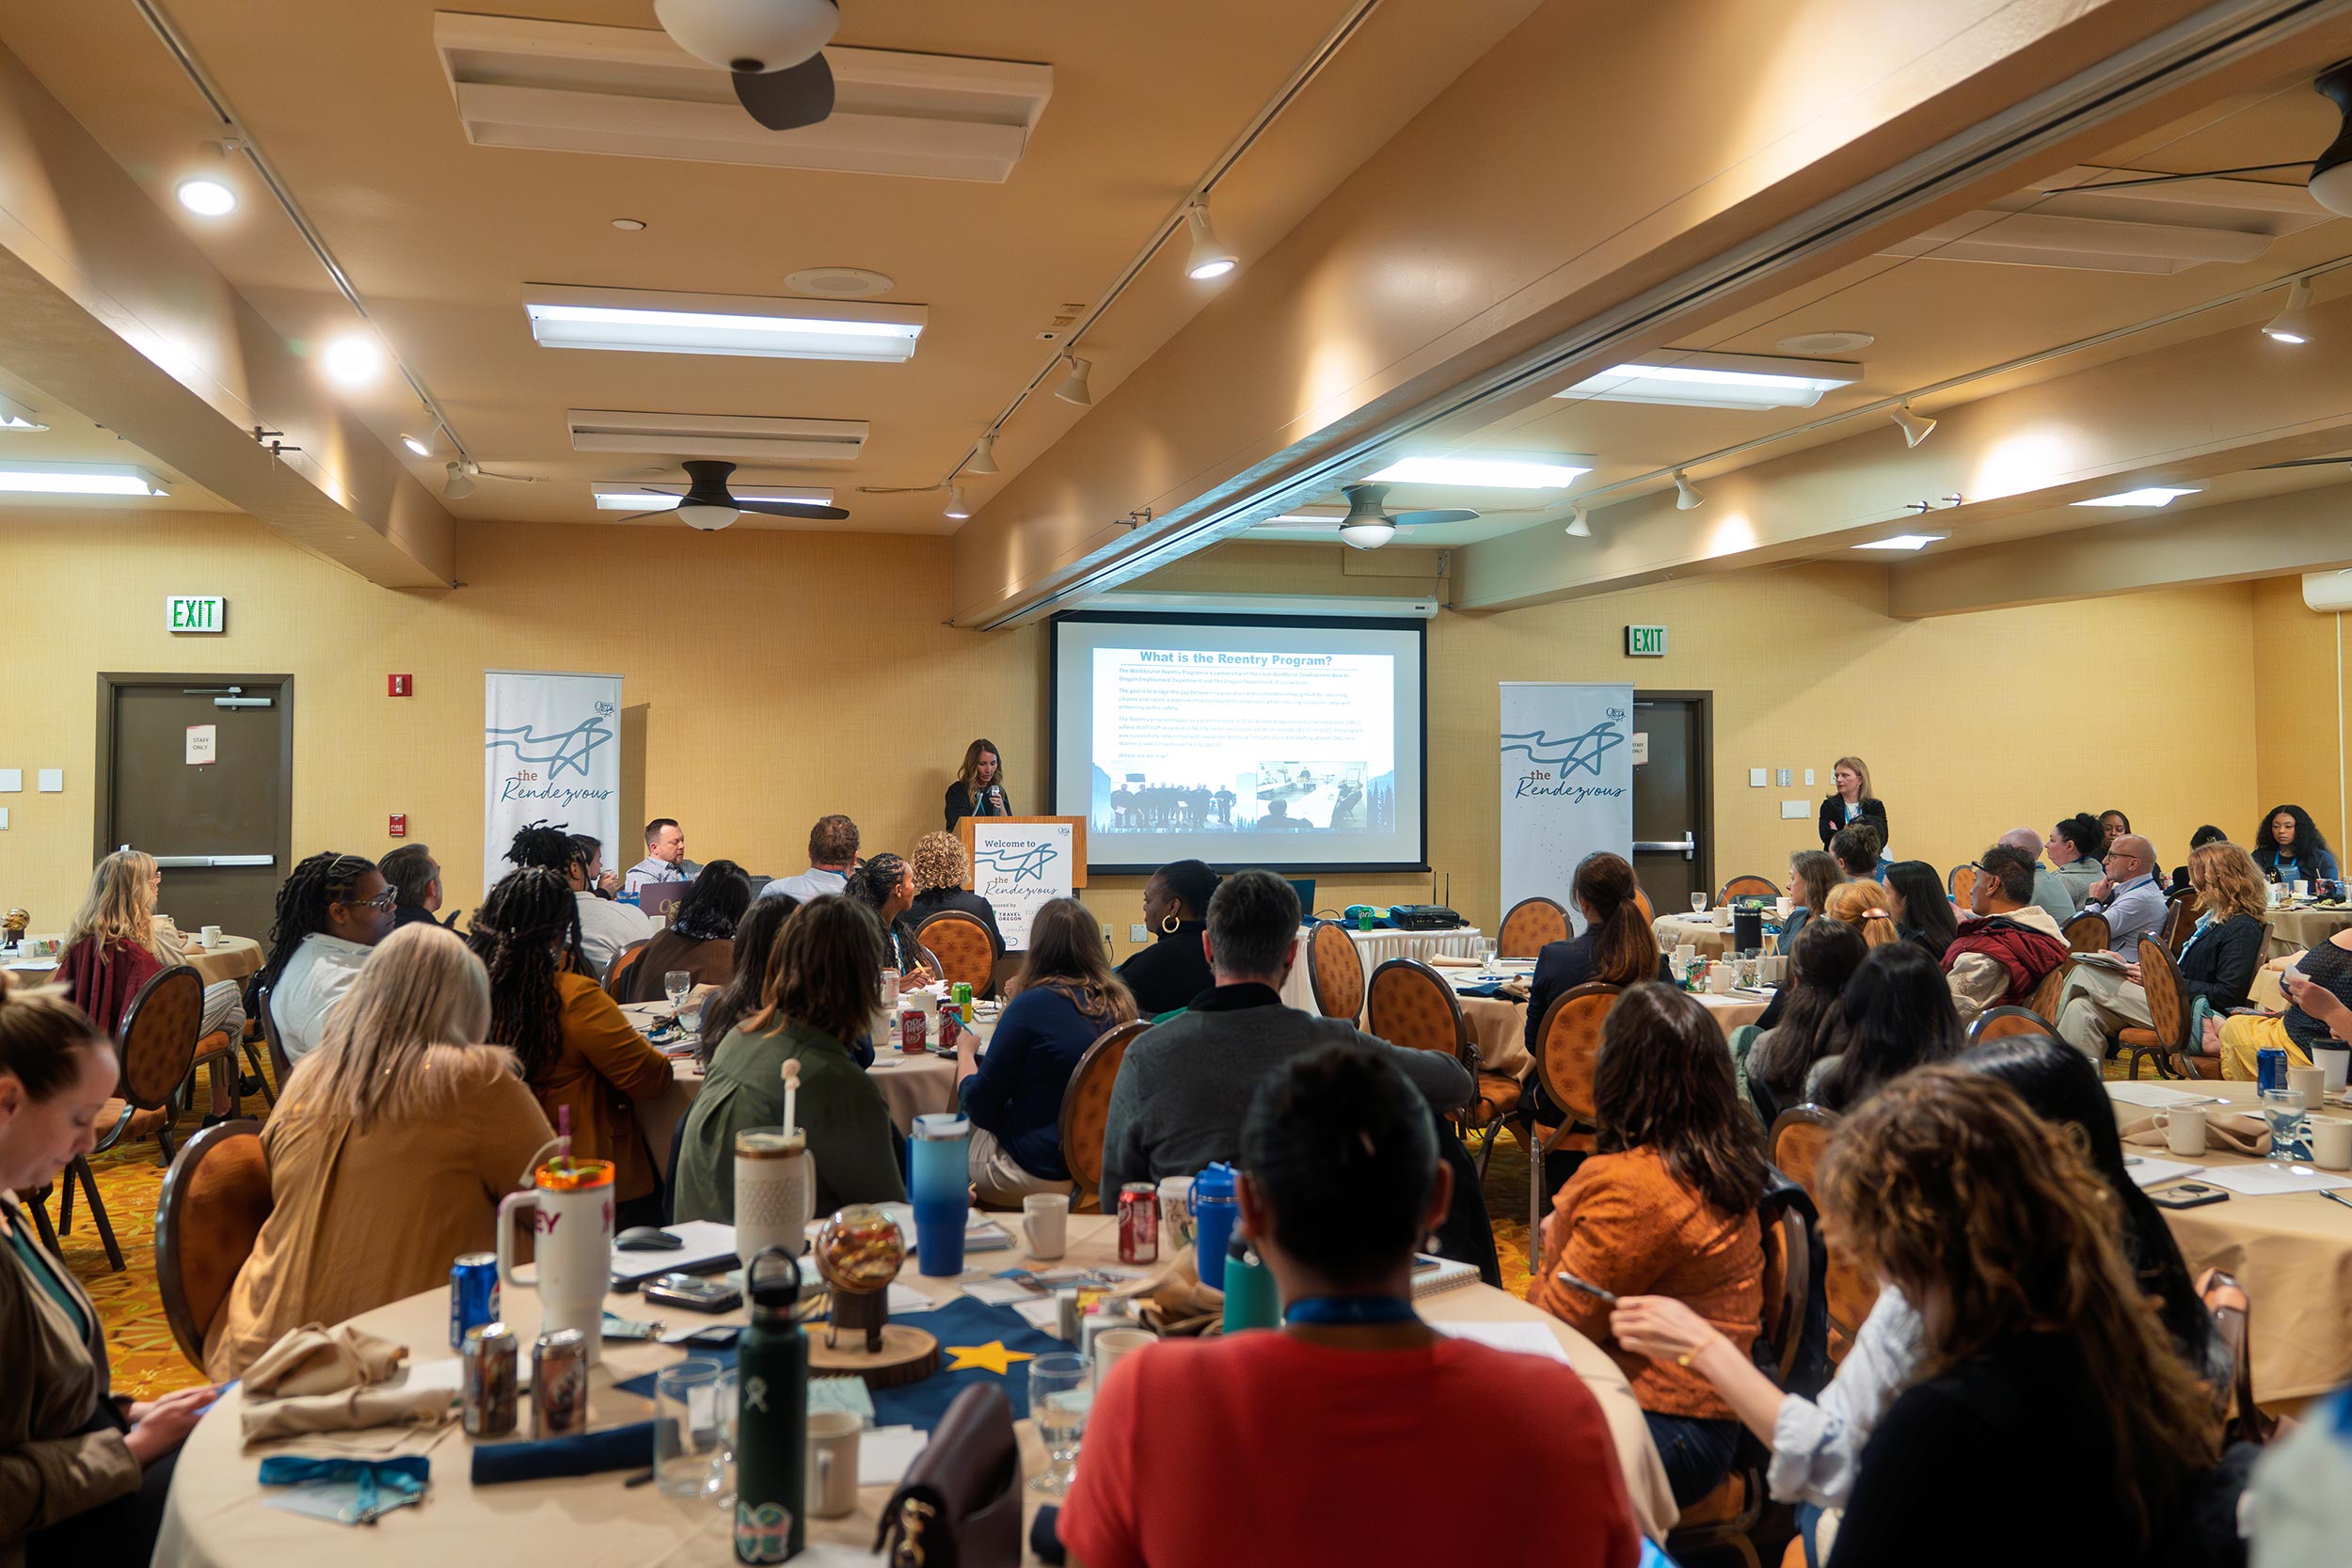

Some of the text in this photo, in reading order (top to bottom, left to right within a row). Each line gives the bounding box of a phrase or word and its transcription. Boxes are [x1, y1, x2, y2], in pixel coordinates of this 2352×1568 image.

[173, 600, 215, 627] EXIT
[1633, 628, 1663, 652] EXIT
[1140, 651, 1332, 667] What is the Reentry Program?
[518, 769, 538, 781] the
[1530, 770, 1551, 780] the
[501, 777, 614, 808] Rendezvous
[1515, 776, 1626, 804] Rendezvous
[984, 881, 1059, 900] Rendezvous
